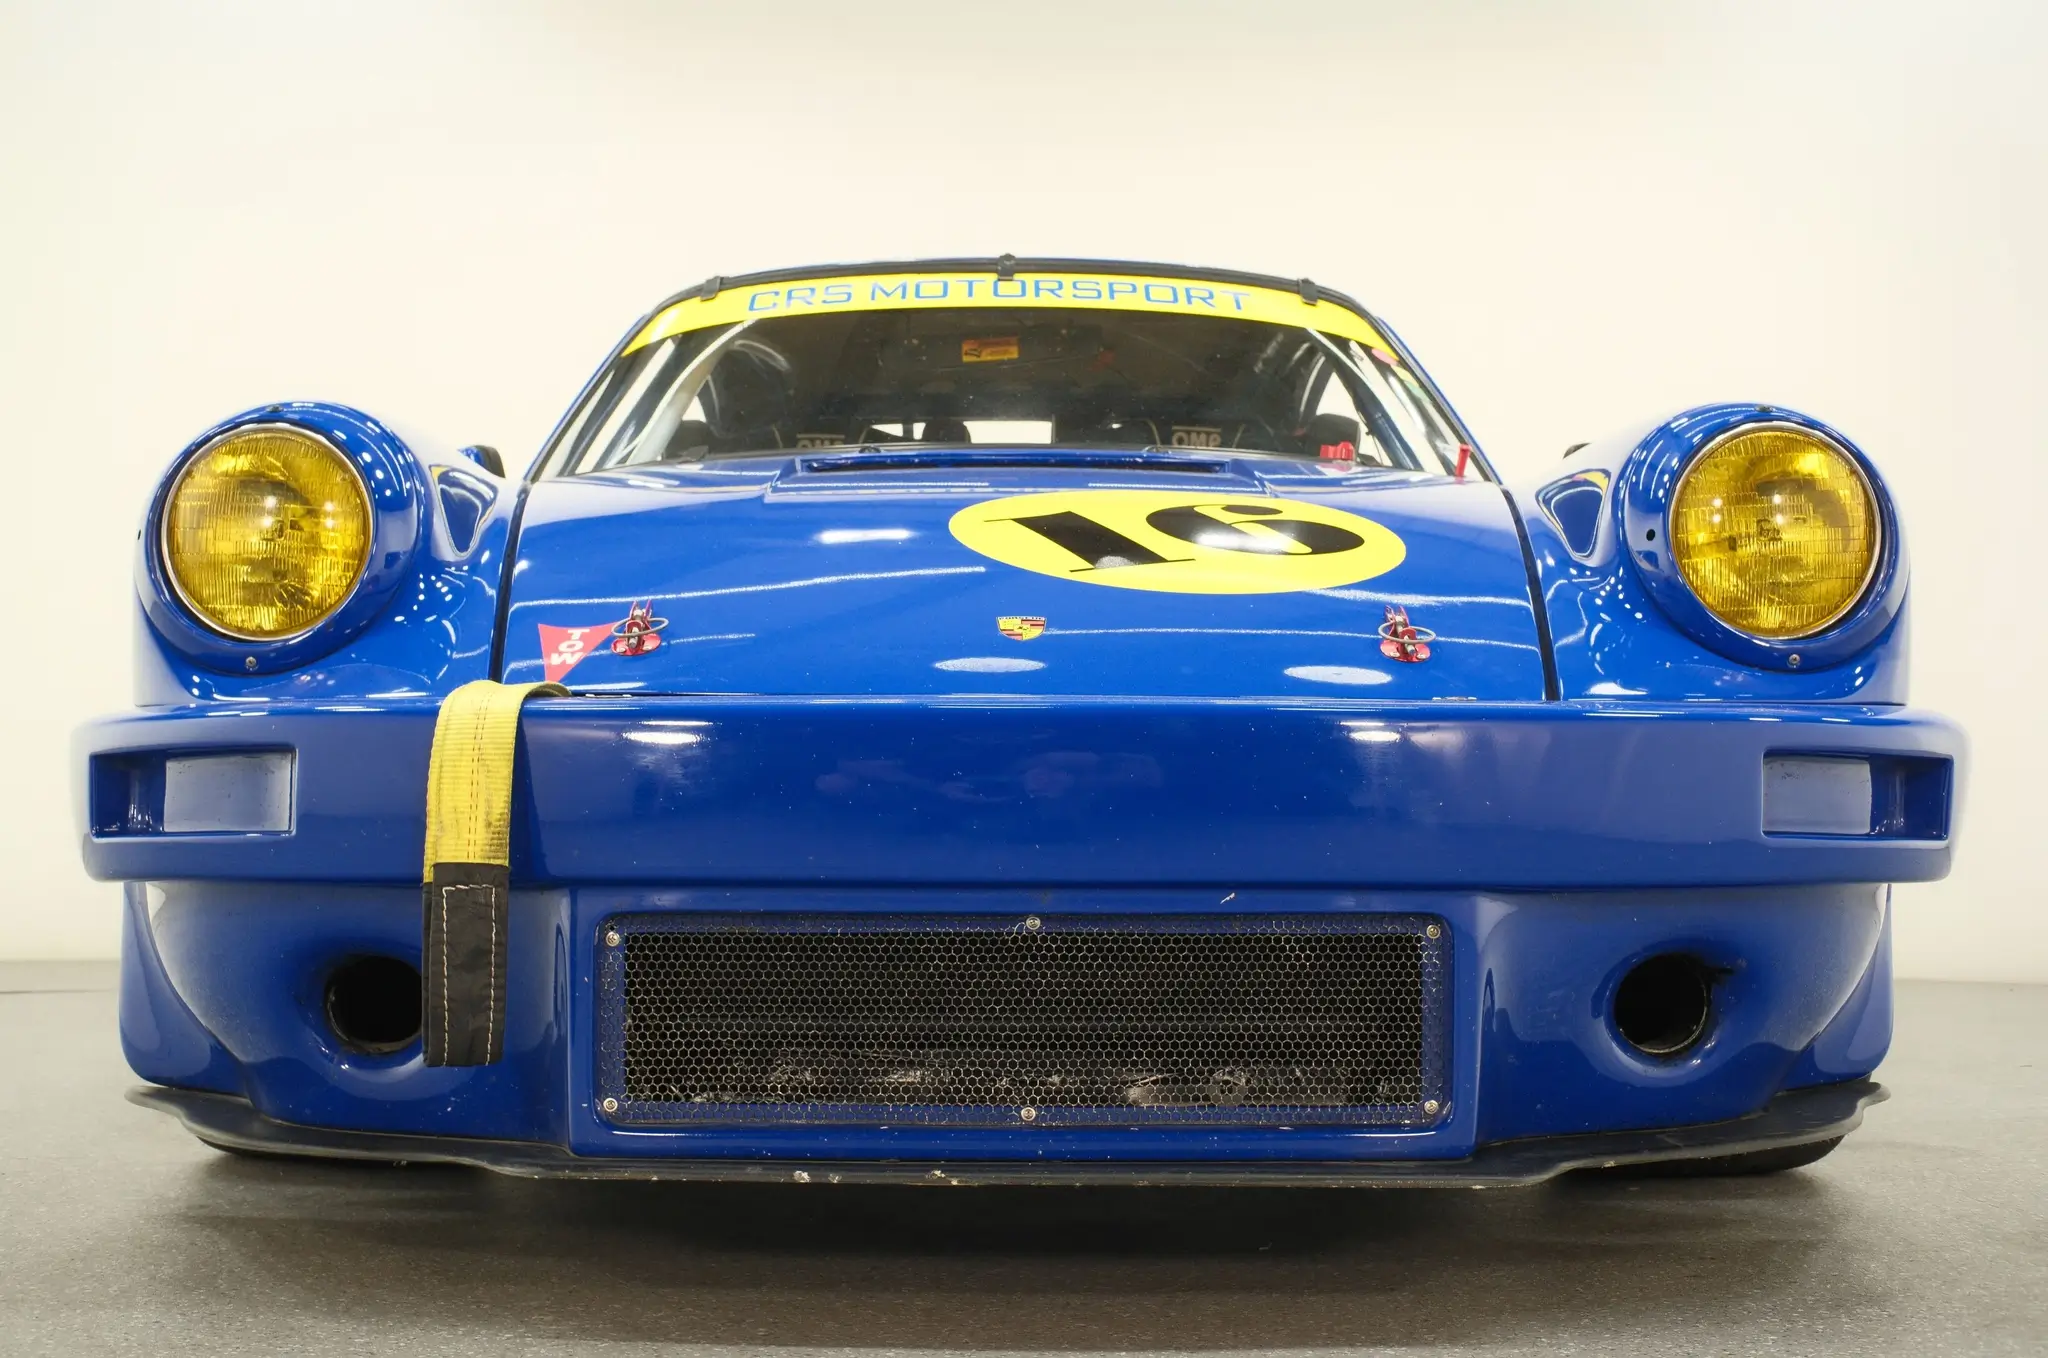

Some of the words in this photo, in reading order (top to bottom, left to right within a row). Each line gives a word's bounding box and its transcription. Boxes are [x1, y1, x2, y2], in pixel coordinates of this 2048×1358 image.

[748, 284, 853, 312] CRS
[870, 279, 1251, 311] MOTORSPORT
[983, 503, 1365, 573] 16
[550, 628, 590, 666] TOW
